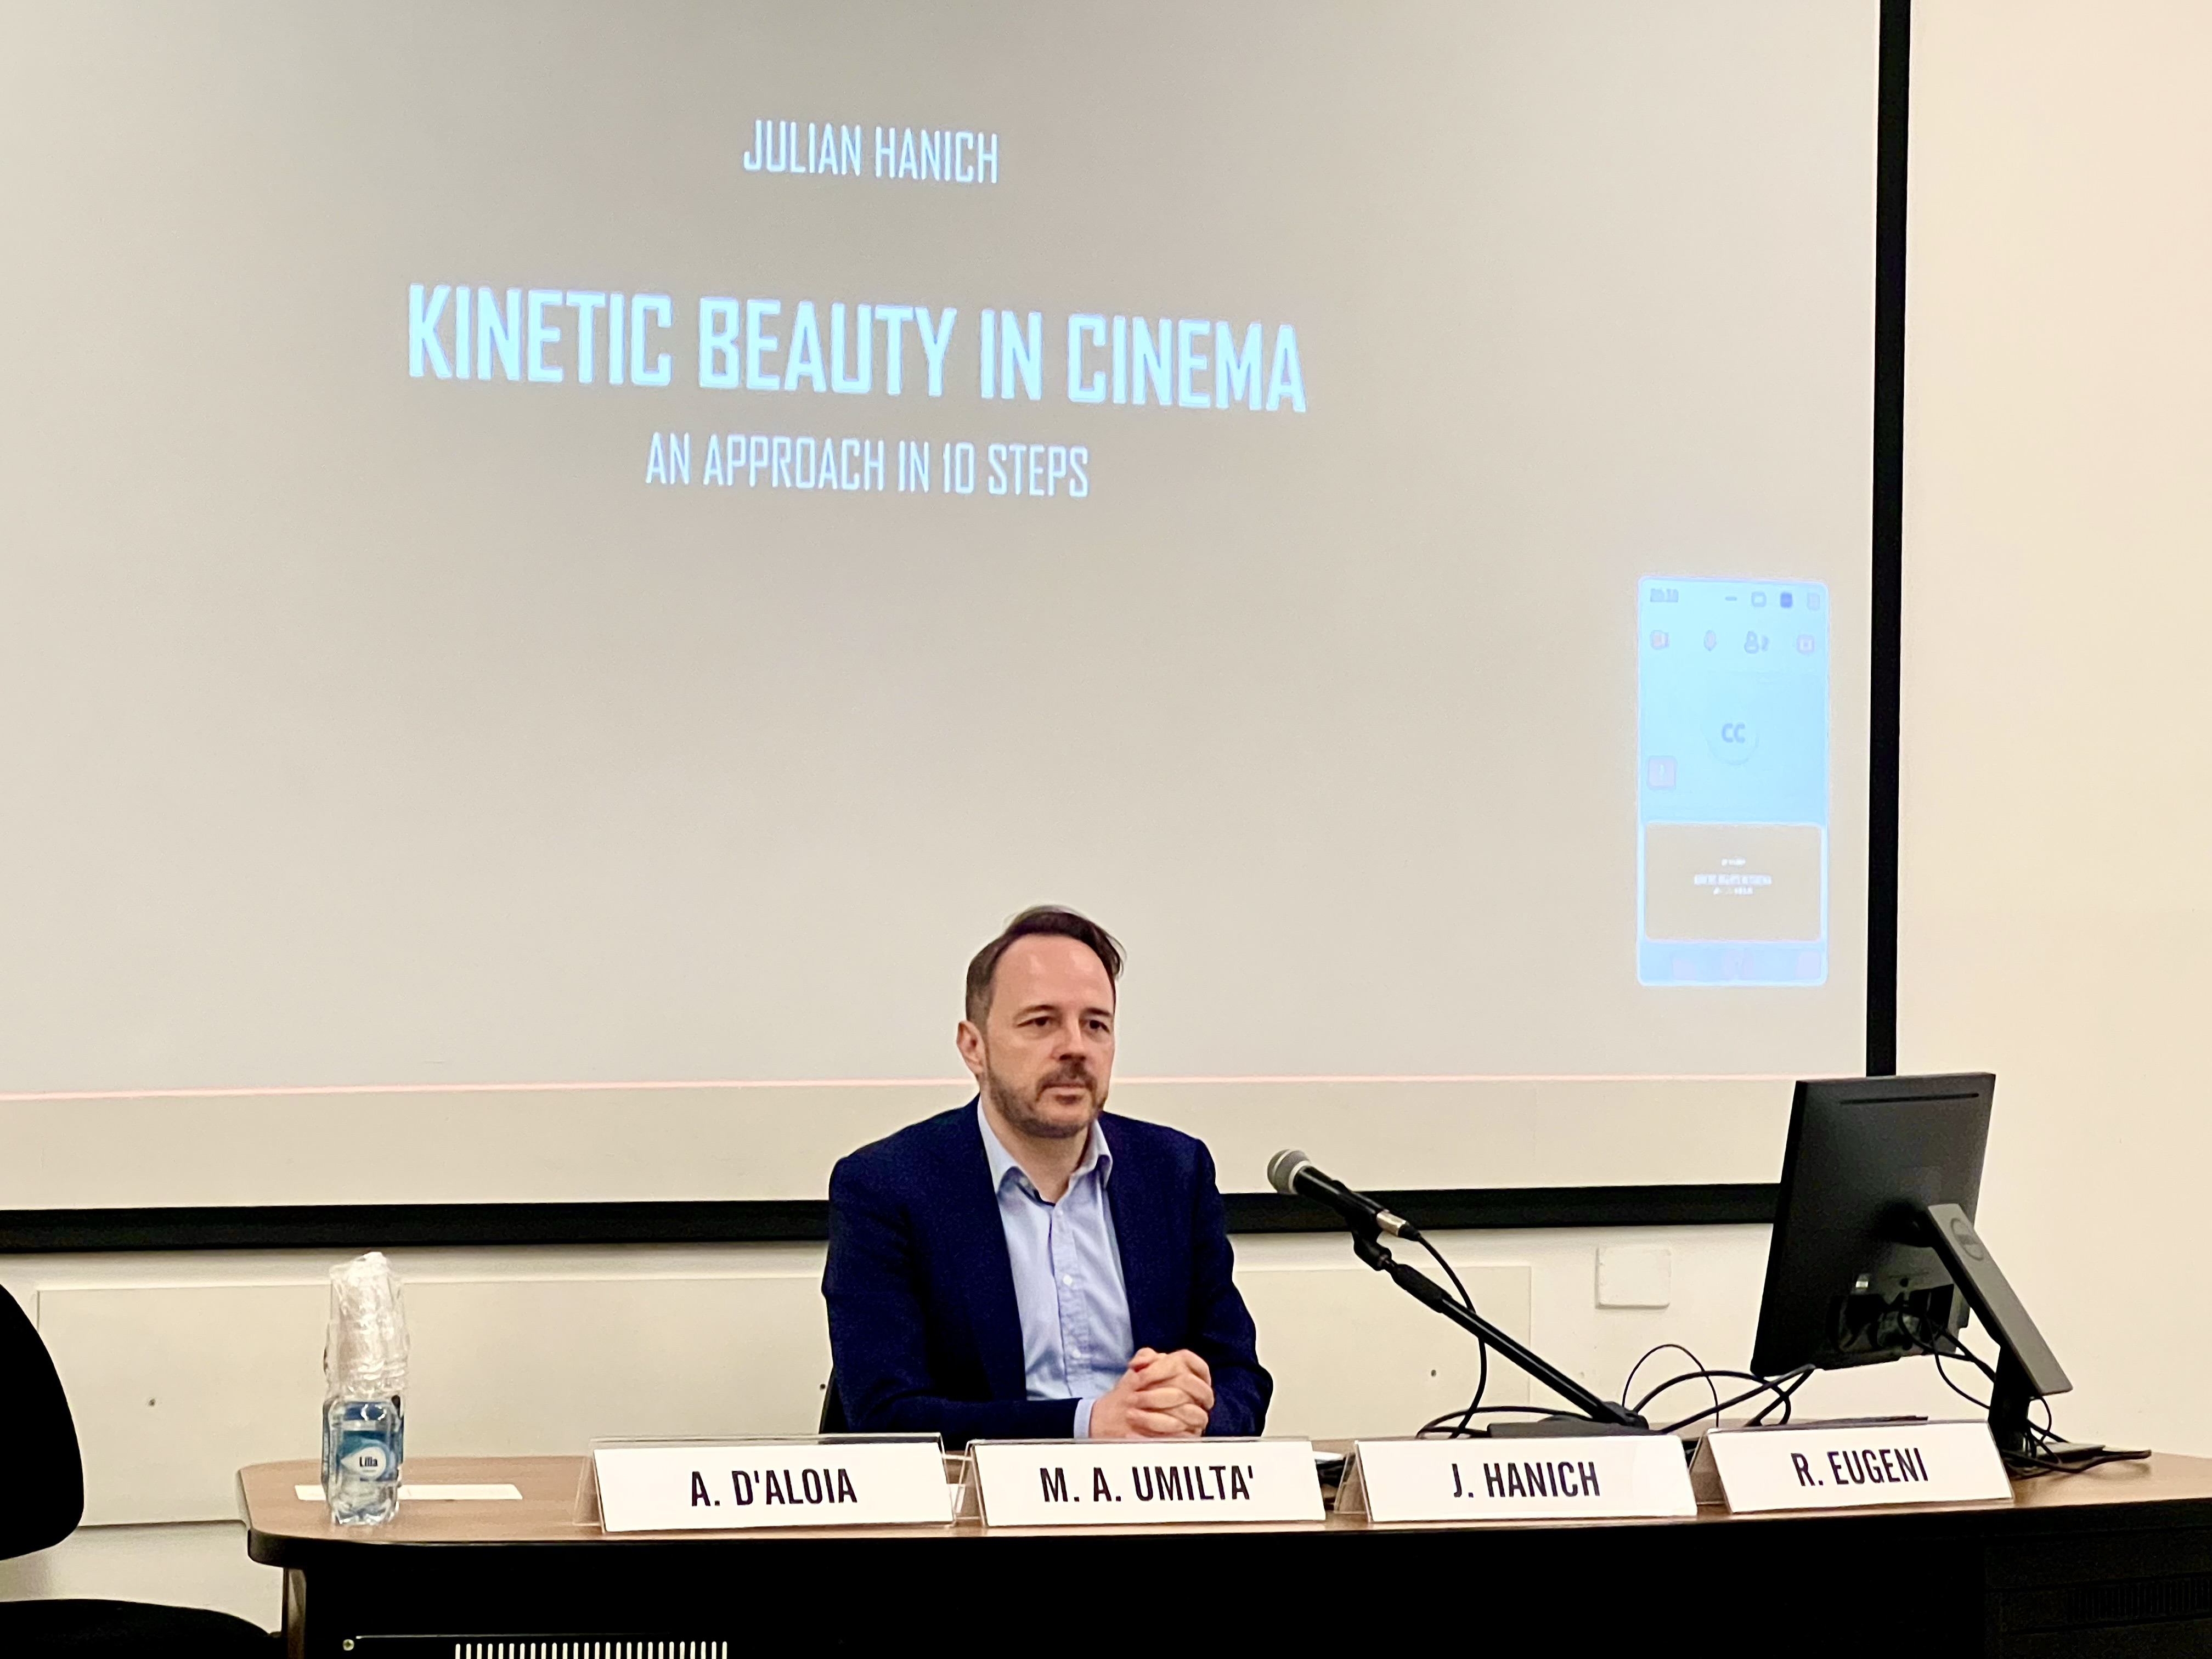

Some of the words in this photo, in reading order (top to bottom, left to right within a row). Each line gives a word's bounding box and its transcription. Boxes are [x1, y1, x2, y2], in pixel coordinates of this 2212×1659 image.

[743, 119, 862, 176] JULIAN
[874, 127, 999, 183] HANICH
[408, 283, 674, 386] KINETIC
[698, 296, 957, 397] BEAUTY
[980, 309, 1043, 400] IN
[1067, 313, 1307, 413] CINEMA
[646, 432, 691, 485] AN
[703, 433, 885, 492] APPROACH
[898, 441, 930, 493] IN
[943, 442, 975, 495] 10
[988, 443, 1089, 498] STEPS
[691, 1471, 720, 1506] A.
[732, 1468, 857, 1506] D'ALOIA
[1040, 1467, 1080, 1502] M.
[1093, 1467, 1121, 1502] A.
[1132, 1465, 1254, 1501] UMILTA'
[1452, 1463, 1474, 1498] J.
[1483, 1462, 1600, 1497] HANICH
[1791, 1453, 1824, 1487] R.
[1827, 1447, 1928, 1485] EUGENI
